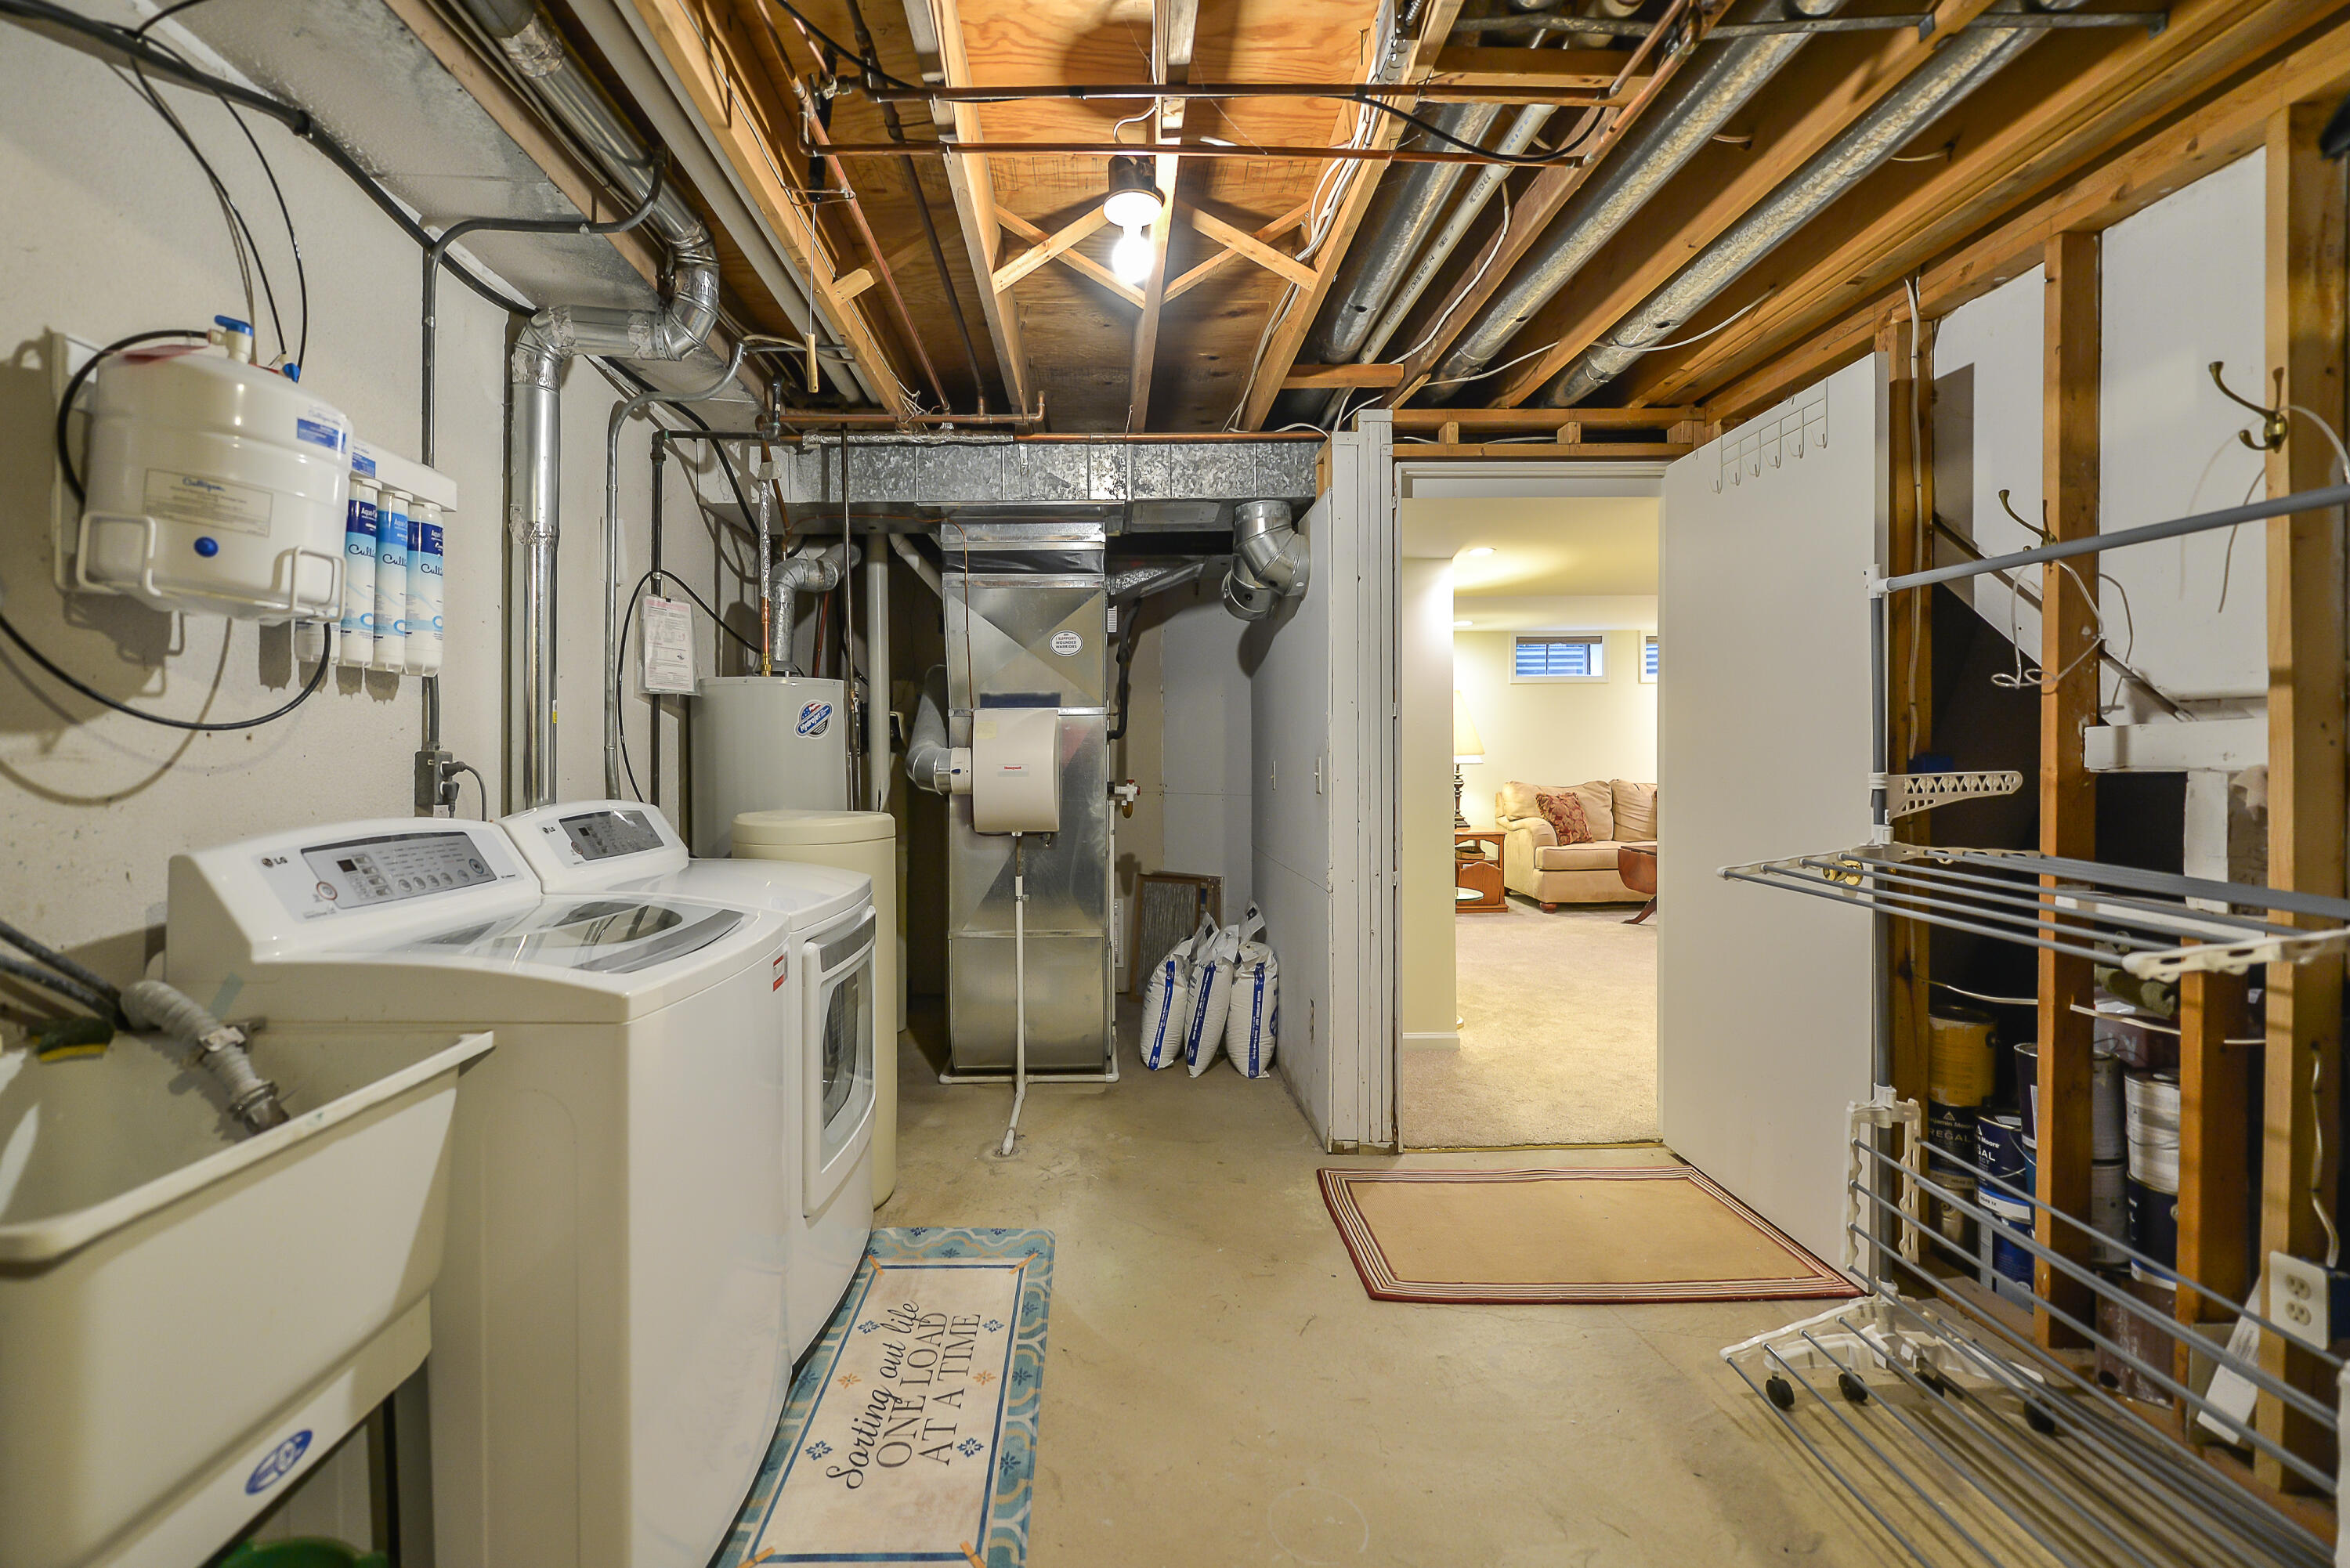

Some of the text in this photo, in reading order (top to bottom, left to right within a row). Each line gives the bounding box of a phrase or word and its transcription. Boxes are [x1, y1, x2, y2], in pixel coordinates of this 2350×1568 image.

[799, 712, 821, 732] Hydrojet
[273, 856, 288, 865] LG
[1981, 1136, 2000, 1149] Moore
[825, 1299, 931, 1490] Sorting out life
[876, 1312, 948, 1469] ONE LOAD
[918, 1313, 982, 1466] AT A TIME
